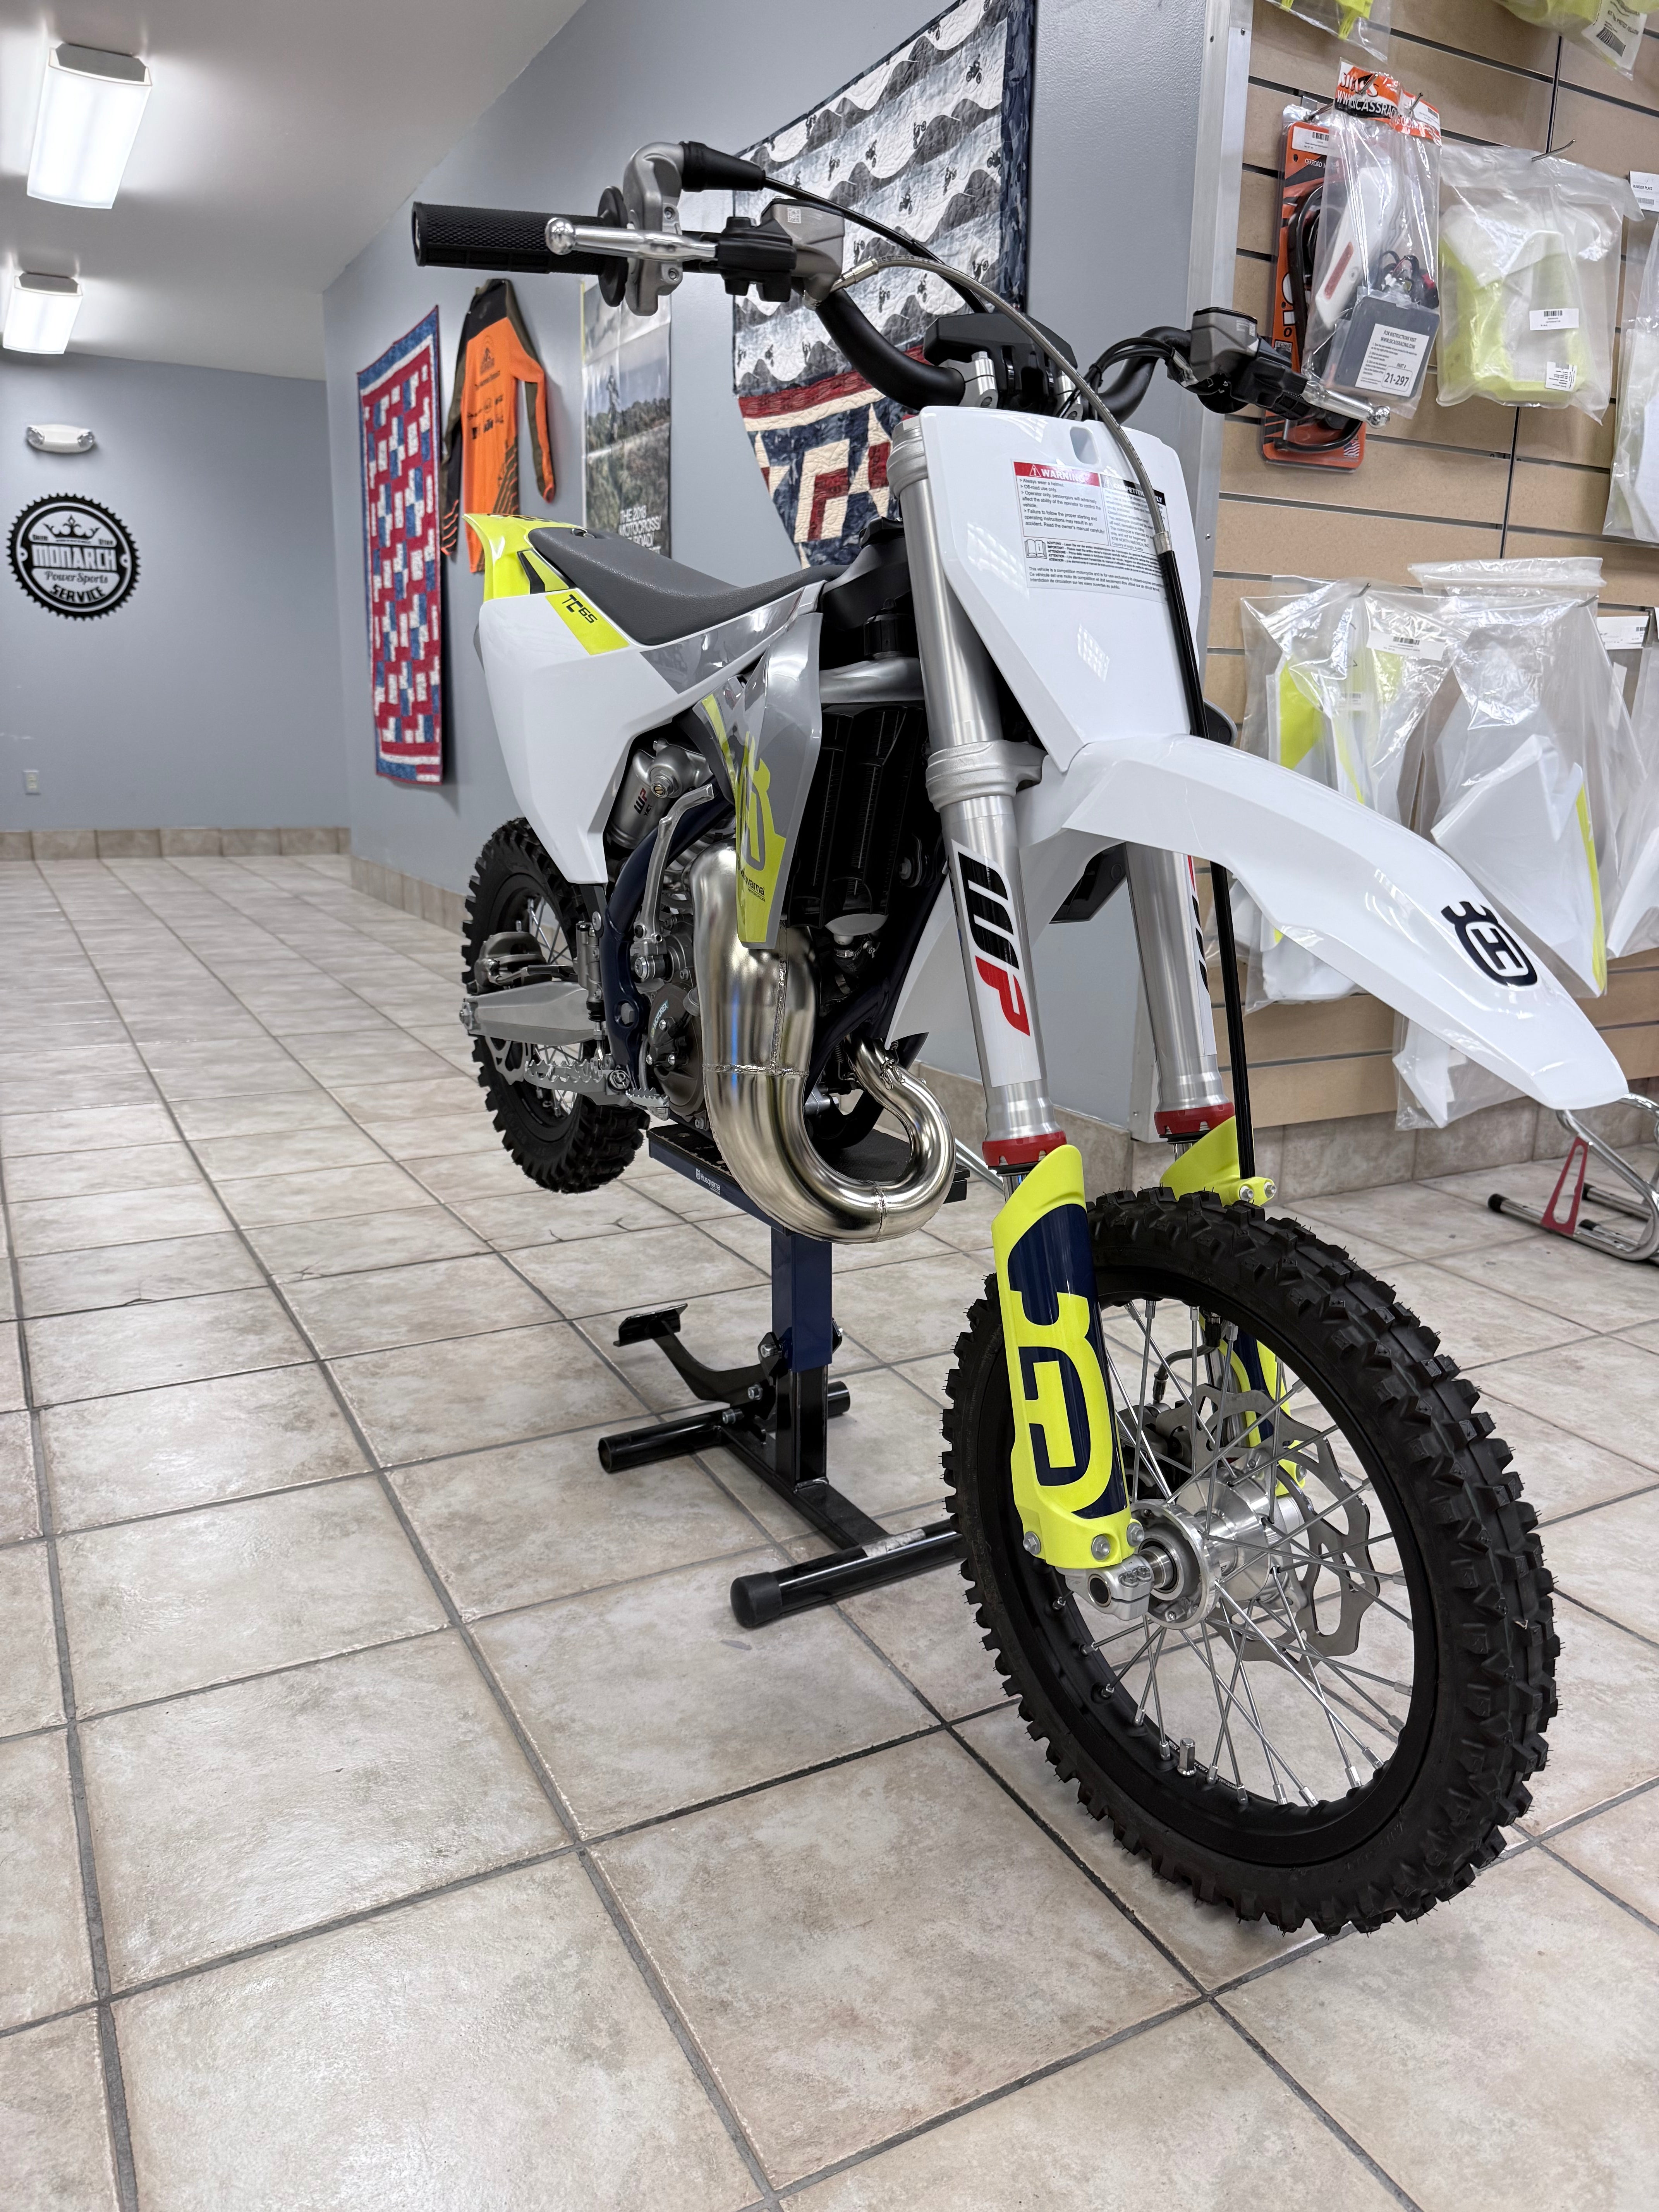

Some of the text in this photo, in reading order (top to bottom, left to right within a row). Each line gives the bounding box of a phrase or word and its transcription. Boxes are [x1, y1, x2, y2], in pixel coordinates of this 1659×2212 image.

[1389, 331, 1409, 340] INSTRUCTIONS
[1384, 373, 1409, 387] 21-297
[1041, 469, 1090, 483] WARNING
[620, 505, 647, 524] THE 2018
[32, 544, 117, 571] MONARCH
[50, 584, 106, 602] SERVICE
[634, 788, 647, 814] WP
[958, 851, 1030, 1036] WP
[653, 1000, 668, 1029] MOTOREX
[701, 1173, 720, 1191] Husqvarna
